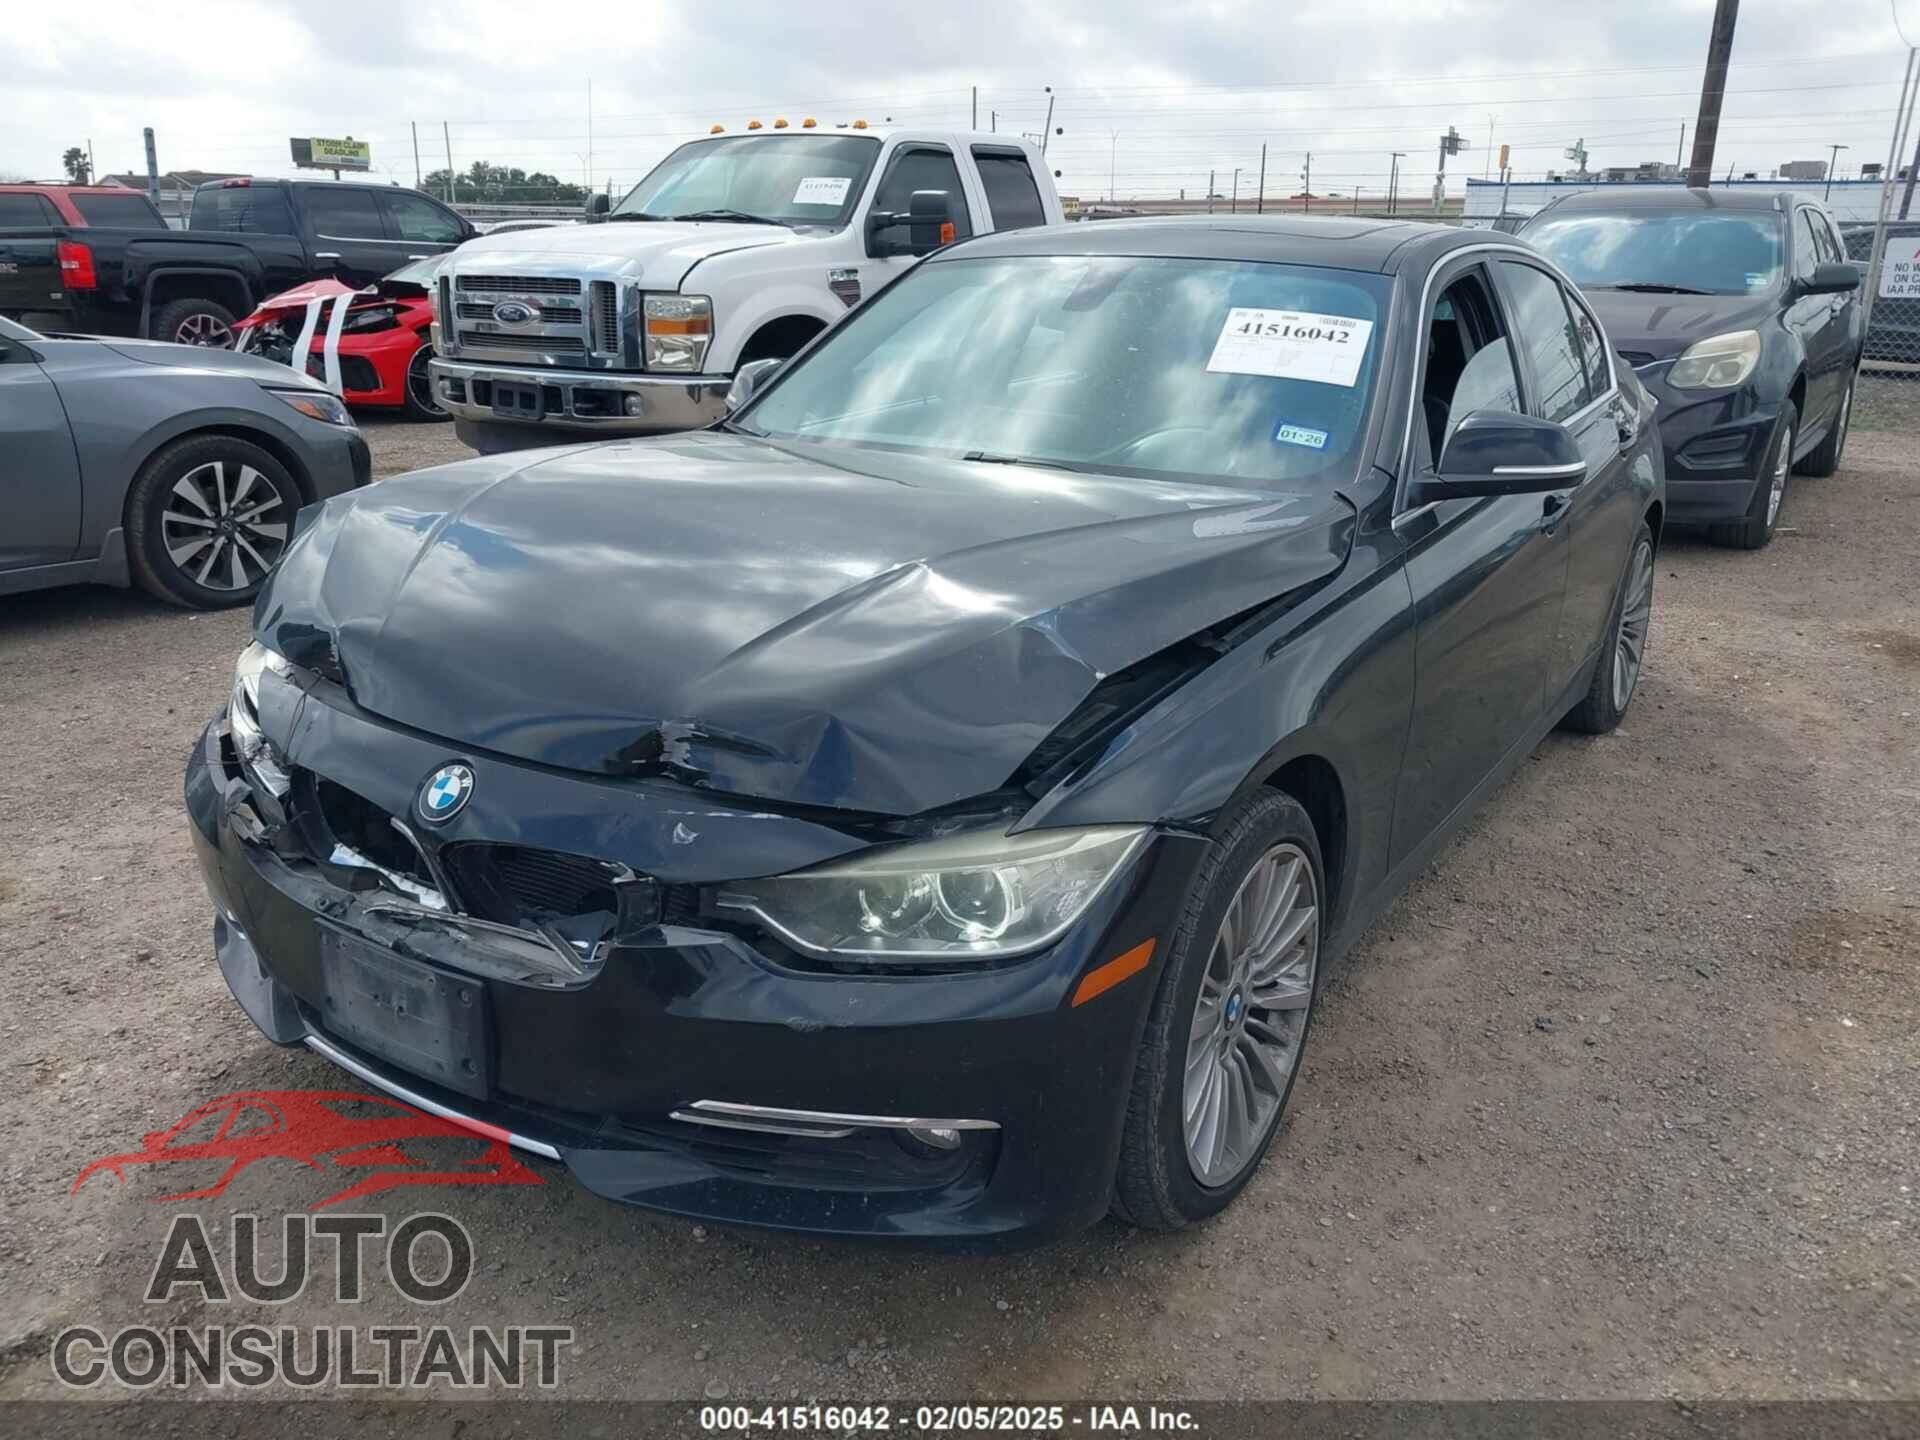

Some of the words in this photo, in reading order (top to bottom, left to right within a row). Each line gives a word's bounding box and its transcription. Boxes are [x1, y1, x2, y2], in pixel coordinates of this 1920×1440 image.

[1895, 262, 1910, 272] NO
[1894, 273, 1909, 283] ON
[1887, 284, 1904, 294] IAA
[1236, 321, 1351, 344] 41516042
[434, 765, 473, 788] BMW
